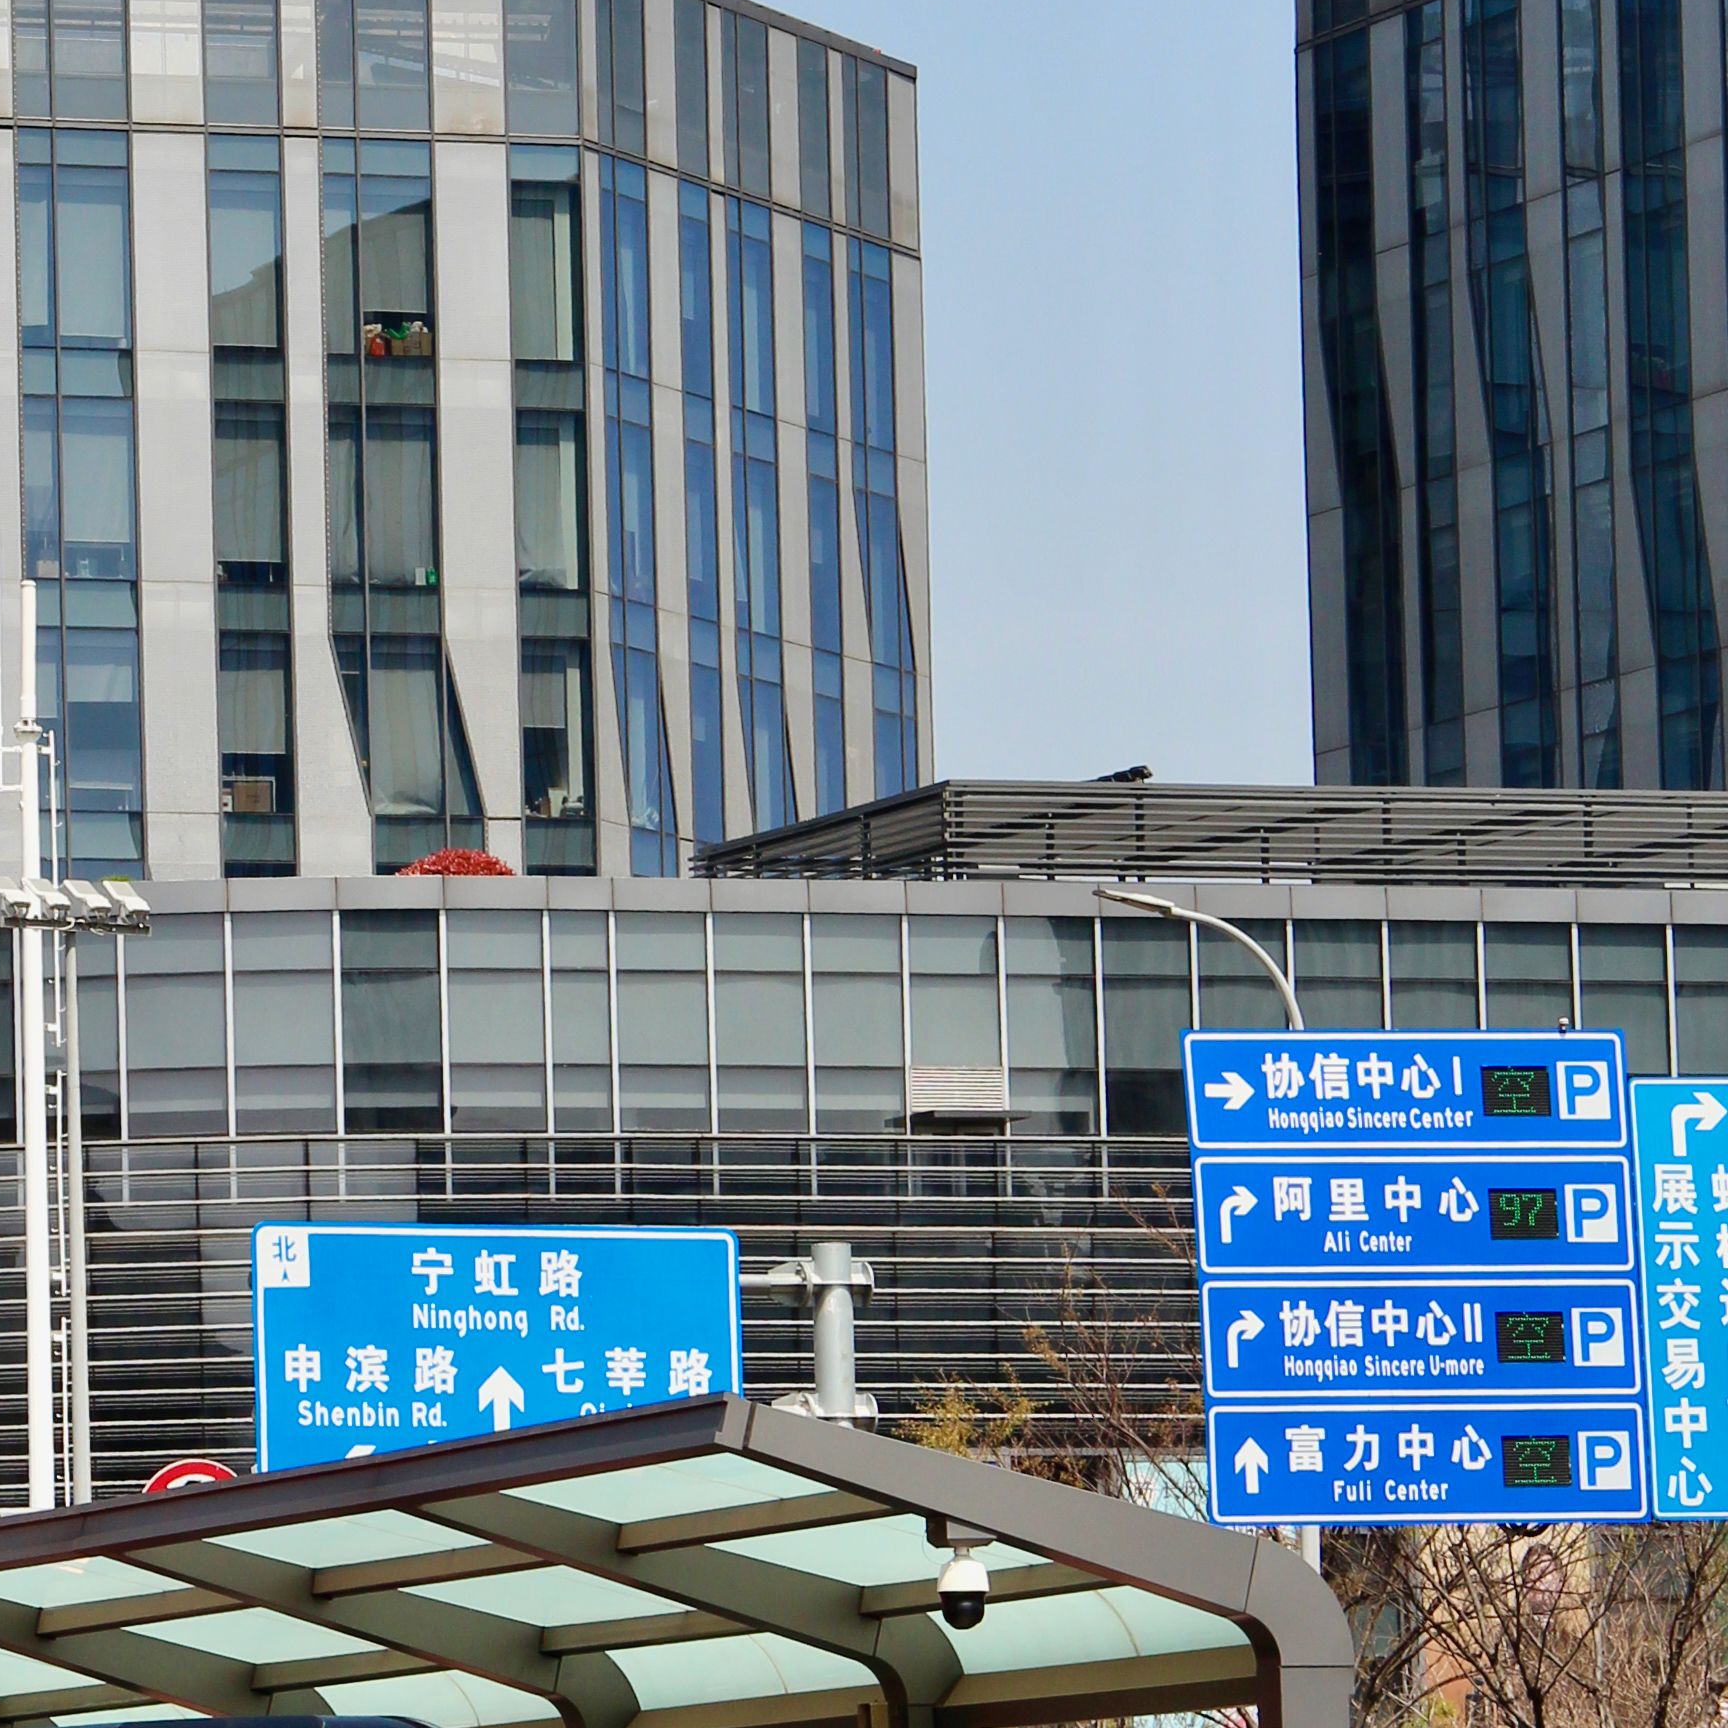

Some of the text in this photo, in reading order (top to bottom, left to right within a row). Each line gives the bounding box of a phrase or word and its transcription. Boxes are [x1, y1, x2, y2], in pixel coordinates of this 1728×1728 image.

[1489, 1066, 1538, 1115] 空
[1268, 1106, 1474, 1135] Hongqiao Sincere Center
[1272, 1175, 1480, 1224] 阿里中心
[1498, 1193, 1544, 1227] 97
[272, 1234, 297, 1263] 北
[1324, 1230, 1413, 1253] Ali Center
[411, 1248, 583, 1298] 宁虹路
[412, 1304, 586, 1338] Ninghong Rd.
[1505, 1312, 1552, 1360] 空
[1652, 1162, 1713, 1508] 展示交易中心
[283, 1343, 459, 1395] 申滨路
[541, 1346, 713, 1397] 七莘路
[1283, 1354, 1485, 1382] Hongqiao Sincere U-more
[297, 1399, 448, 1428] Shenbin Rd.
[1284, 1424, 1492, 1473] 富力中心
[1512, 1435, 1559, 1485] 空
[1332, 1479, 1450, 1503] Fuli Center
